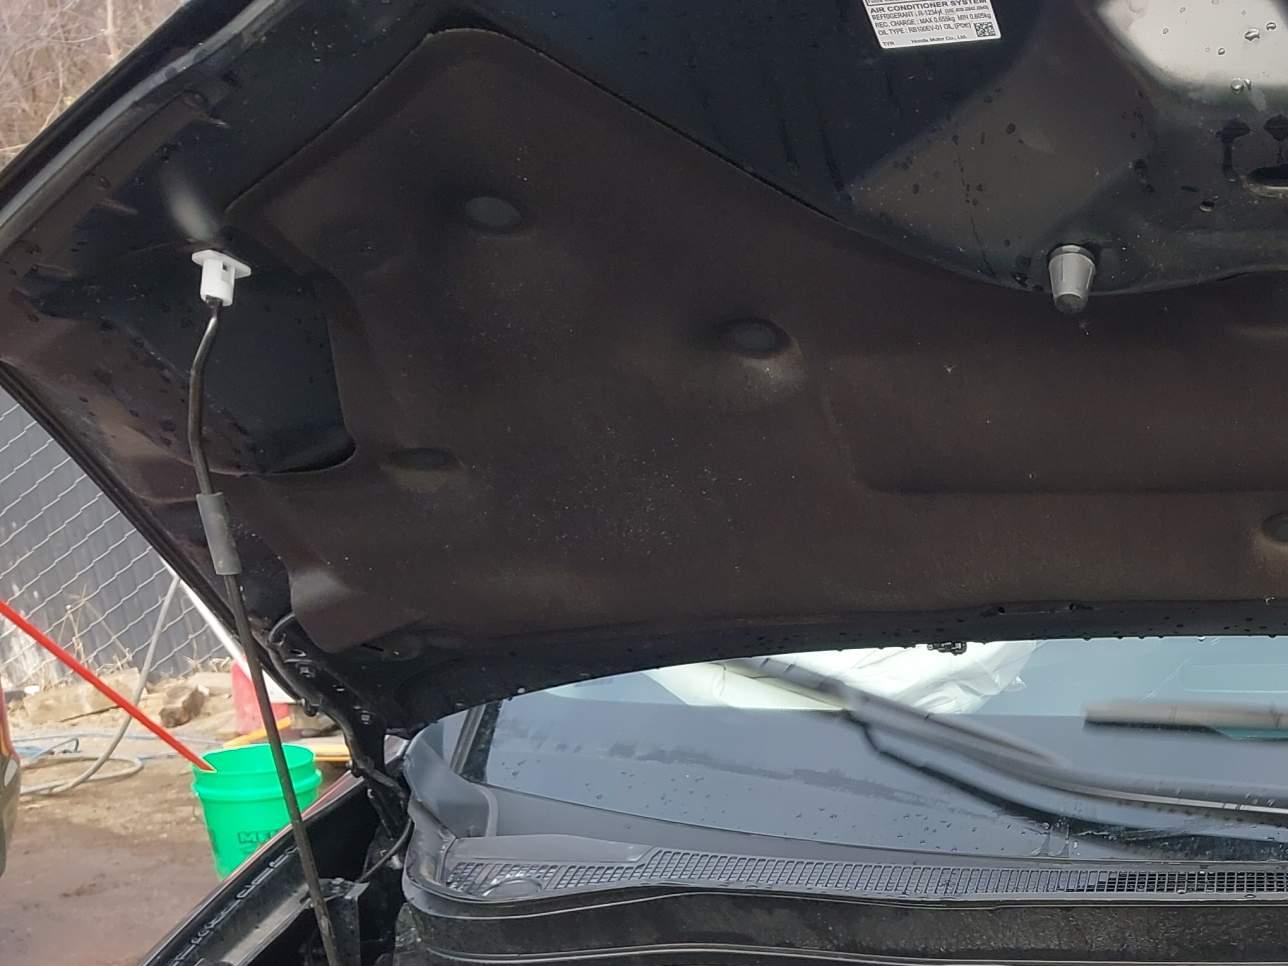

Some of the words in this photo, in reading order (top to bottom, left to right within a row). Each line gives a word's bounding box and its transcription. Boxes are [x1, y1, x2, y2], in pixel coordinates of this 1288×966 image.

[871, 6, 886, 14] AIR
[887, 1, 949, 12] CONDITIONER
[872, 11, 914, 20] REFRIGERANT
